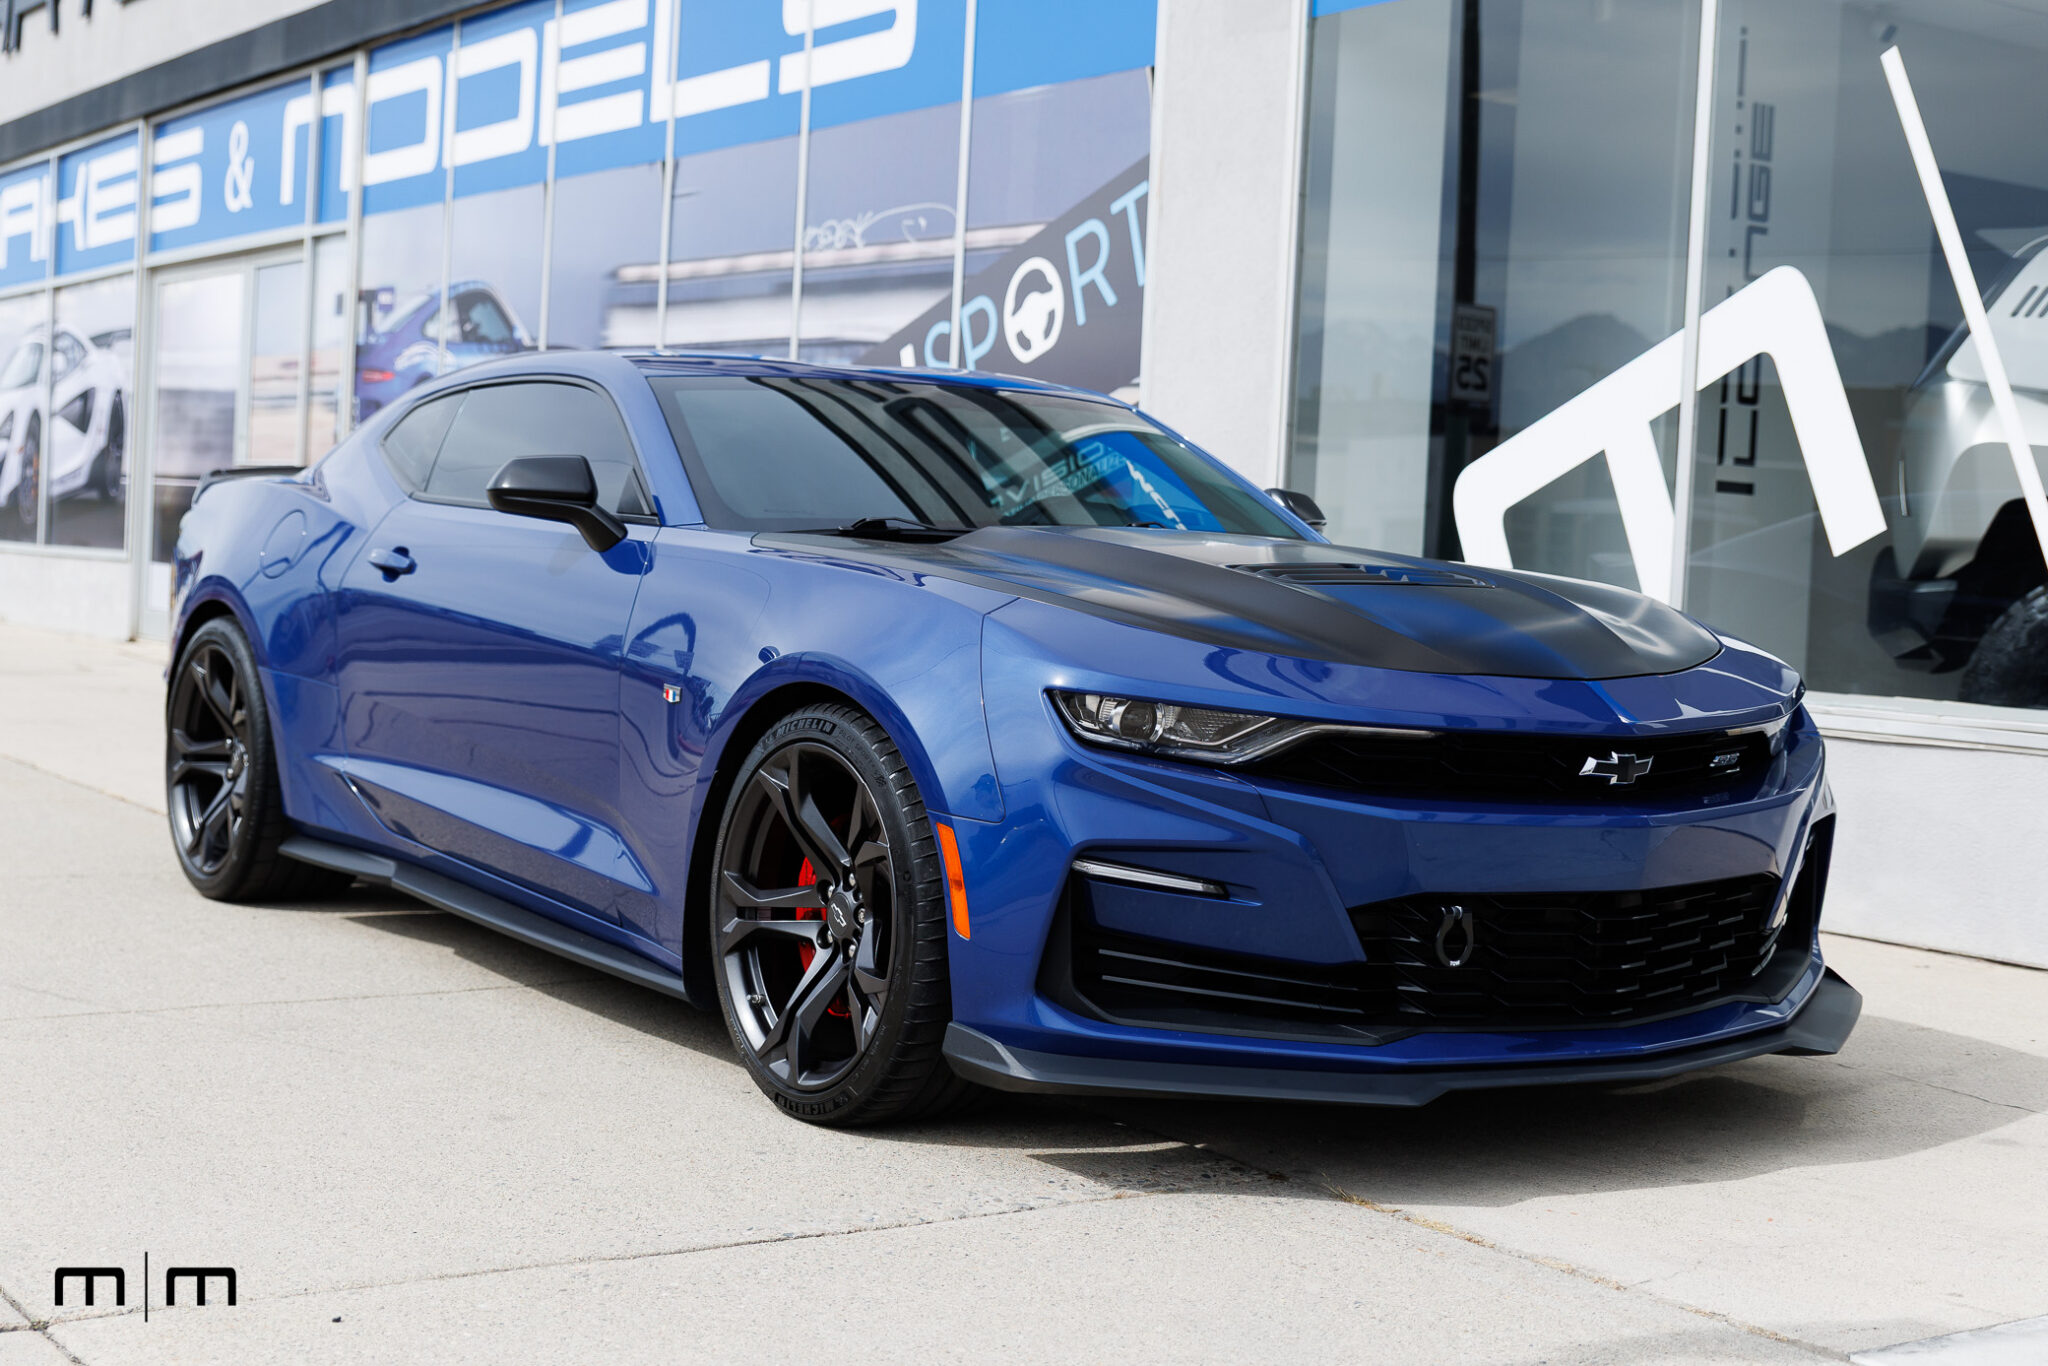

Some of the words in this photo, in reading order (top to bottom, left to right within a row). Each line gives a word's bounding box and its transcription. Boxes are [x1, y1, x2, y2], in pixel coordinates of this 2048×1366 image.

[225, 120, 255, 212] &
[280, 0, 917, 206] MODELS
[924, 180, 1150, 370] SPORT
[775, 718, 835, 738] MICHELIN
